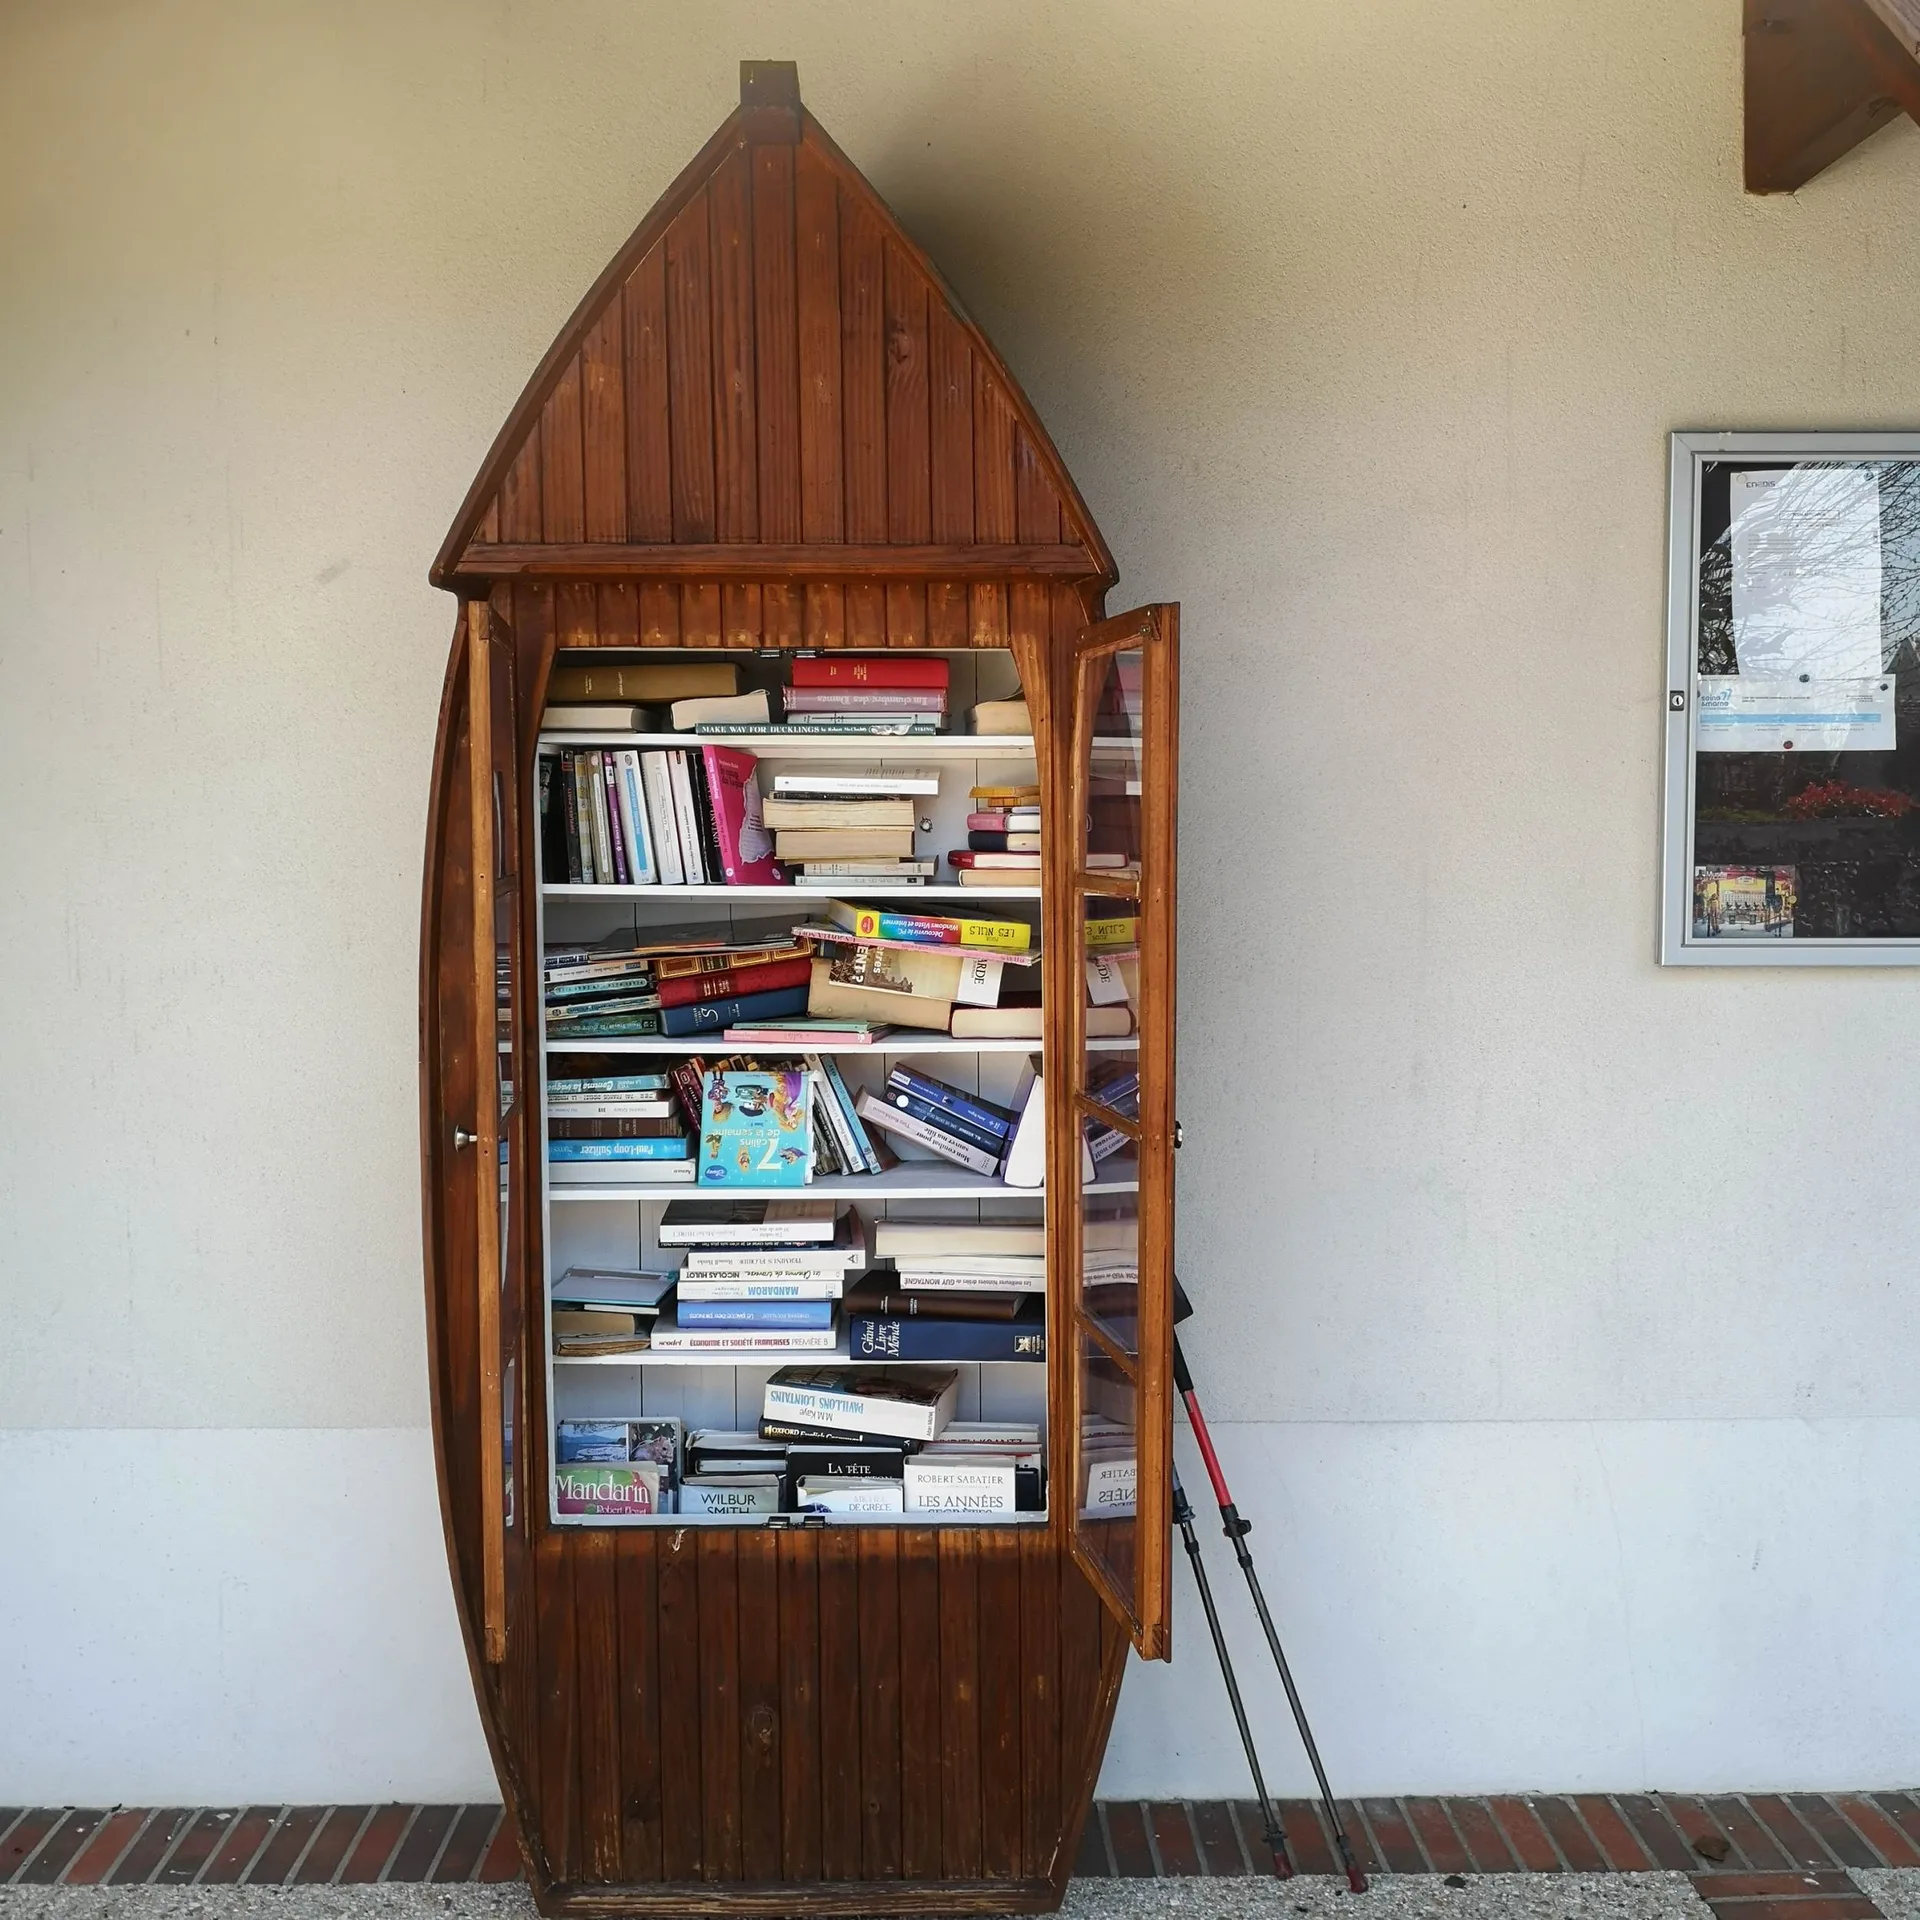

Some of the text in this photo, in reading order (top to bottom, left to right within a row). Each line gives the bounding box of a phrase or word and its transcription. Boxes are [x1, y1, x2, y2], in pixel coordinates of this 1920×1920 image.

[702, 725, 726, 733] MAKE
[729, 725, 747, 733] WAY
[750, 725, 766, 733] FOR
[770, 725, 820, 734] DUCKLINGS
[881, 917, 907, 927] Internet
[914, 920, 930, 928] Vista
[930, 921, 958, 930] Windows
[913, 928, 943, 937] Découvrir
[968, 924, 1014, 938] LES NULS
[854, 946, 869, 973] ENT
[572, 1083, 581, 1092] la
[581, 1079, 613, 1092] Comme
[767, 1128, 780, 1136] de
[923, 1125, 969, 1153] sauver ma fille
[579, 1144, 611, 1156] Sulitzer
[613, 1142, 653, 1155] Paul-Loup
[915, 1129, 971, 1163] Mon combat pour
[740, 1137, 782, 1170] 7 câlins
[705, 1166, 724, 1178] Disney
[745, 1270, 772, 1278] traverse
[774, 1270, 782, 1278] de
[784, 1269, 810, 1280] Chemins
[904, 1277, 940, 1285] MONTAGNÉ
[747, 1285, 799, 1296] MANDAROM
[689, 1338, 720, 1346] ÉCONOMIE
[729, 1338, 753, 1346] SOCIÉTÉ
[754, 1338, 790, 1346] FRANÇAISES
[791, 1337, 821, 1346] PREMIÈRE
[861, 1320, 874, 1354] Grand
[875, 1324, 887, 1351] Livre
[887, 1321, 900, 1356] Monde
[770, 1390, 864, 1414] PAVILLONS LOINTAINS
[798, 1406, 816, 1419] Kaye
[772, 1426, 800, 1436] OXFORD
[827, 1463, 870, 1473] LA TÊTE
[917, 1474, 1004, 1484] ROBERT SABATIER
[556, 1474, 650, 1504] Mandarin
[701, 1494, 756, 1506] WILBUR
[919, 1495, 1003, 1508] LES ANNÉES
